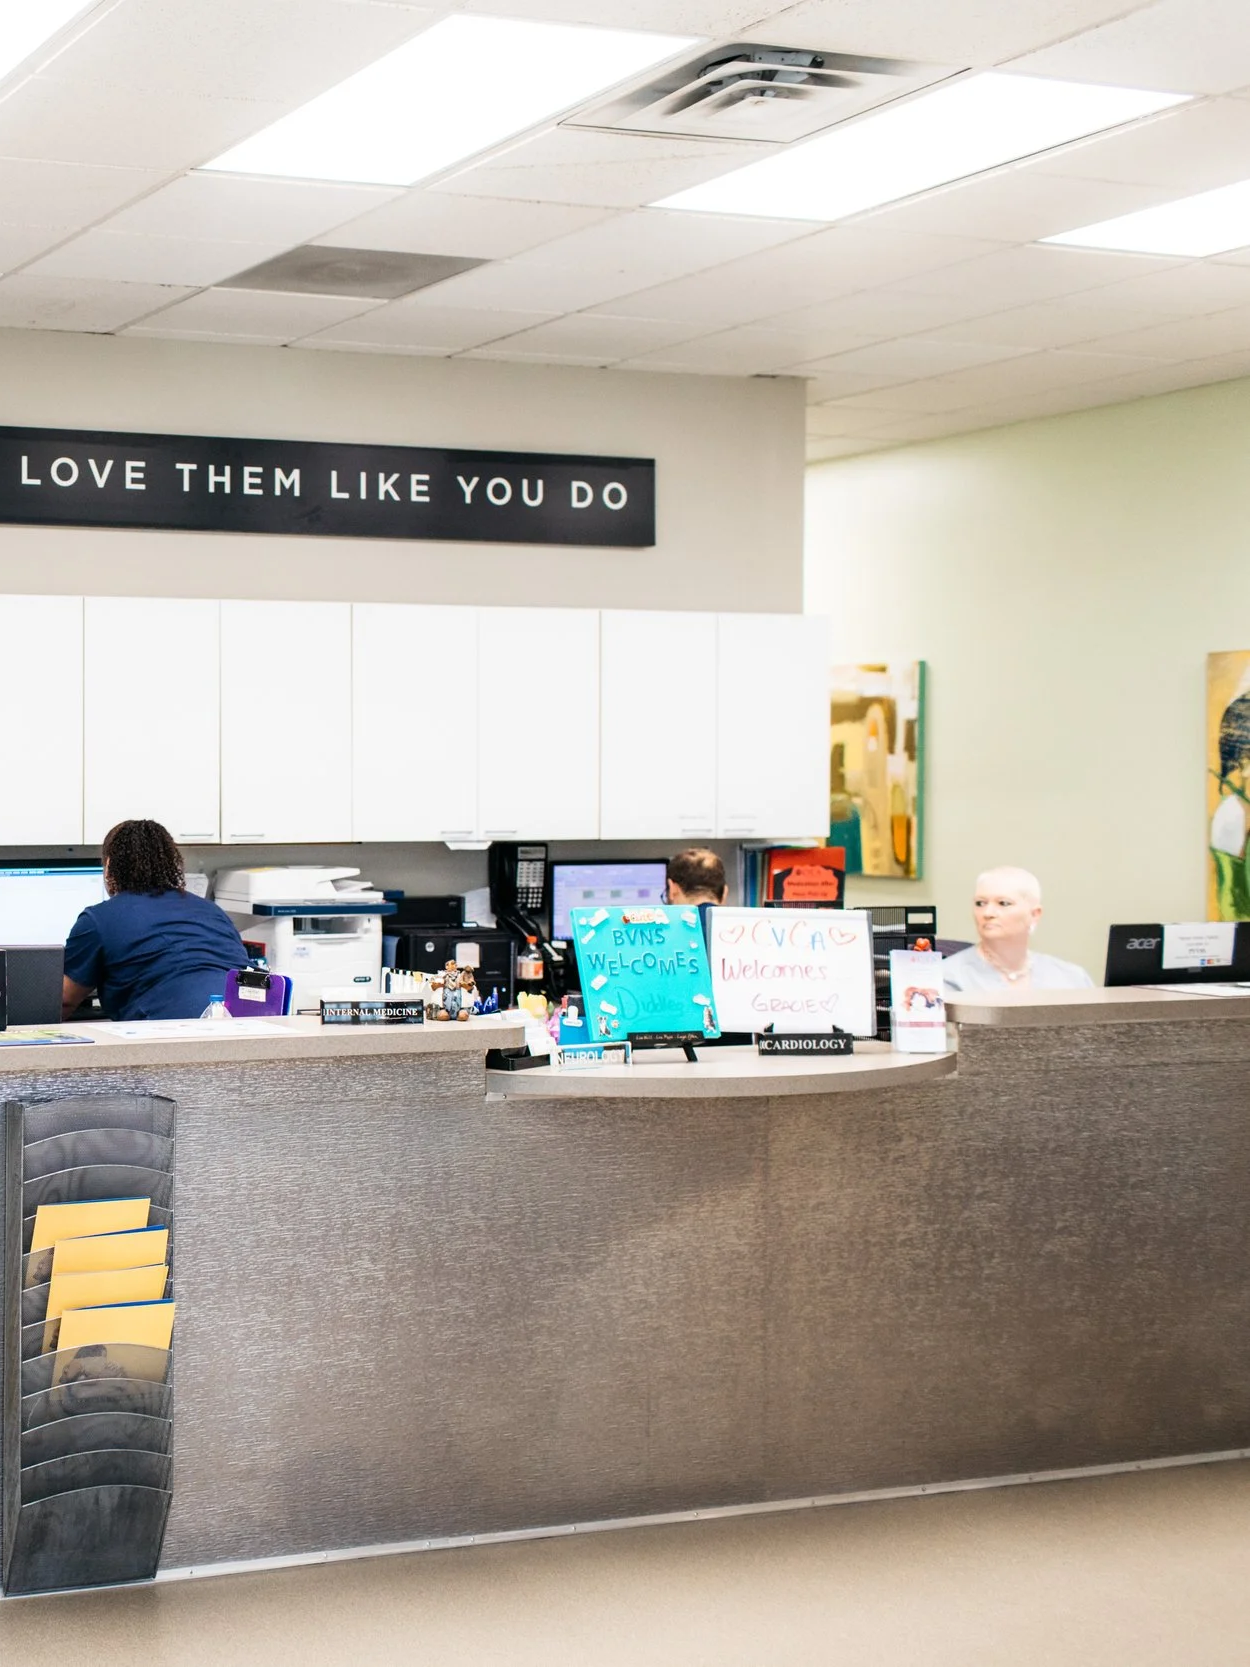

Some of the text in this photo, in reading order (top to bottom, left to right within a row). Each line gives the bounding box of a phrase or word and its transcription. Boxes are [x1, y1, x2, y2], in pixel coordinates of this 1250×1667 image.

[21, 455, 146, 490] LOVE
[175, 463, 300, 497] THEM
[330, 470, 430, 503] LIKE
[456, 475, 544, 507] YOU
[571, 480, 628, 510] DO
[612, 928, 666, 946] BVNS
[1126, 937, 1161, 950] acer
[587, 951, 700, 977] WELCOMES
[721, 957, 829, 982] Welcomes
[326, 1008, 418, 1016] INTERNAL MEDICINE
[751, 993, 818, 1014] GRACIE
[764, 1039, 847, 1050] CARDIOLOGY
